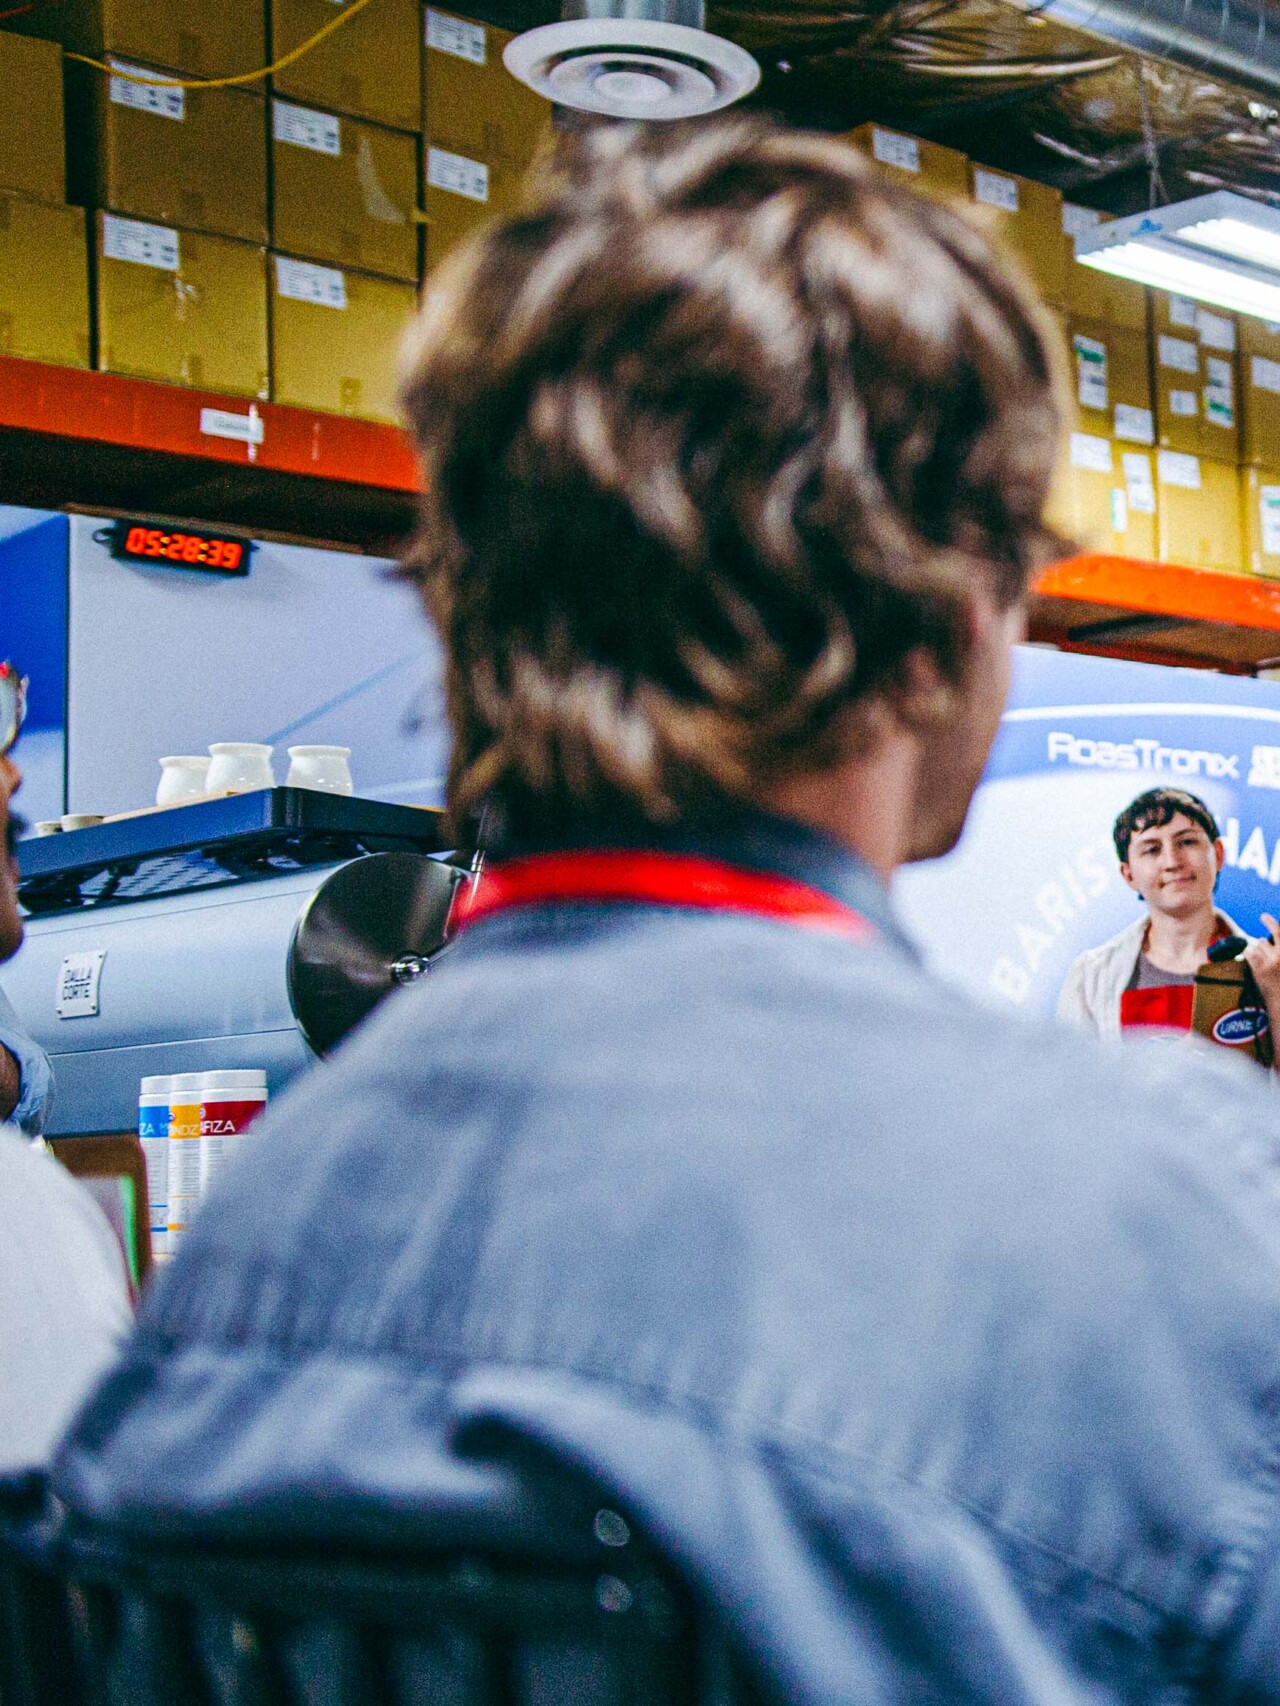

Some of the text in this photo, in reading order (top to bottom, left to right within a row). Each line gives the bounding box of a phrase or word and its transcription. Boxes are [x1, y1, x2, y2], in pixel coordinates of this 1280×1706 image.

[125, 527, 243, 570] 05:28:39
[64, 967, 92, 984] DALLA
[62, 982, 91, 1001] CORTE
